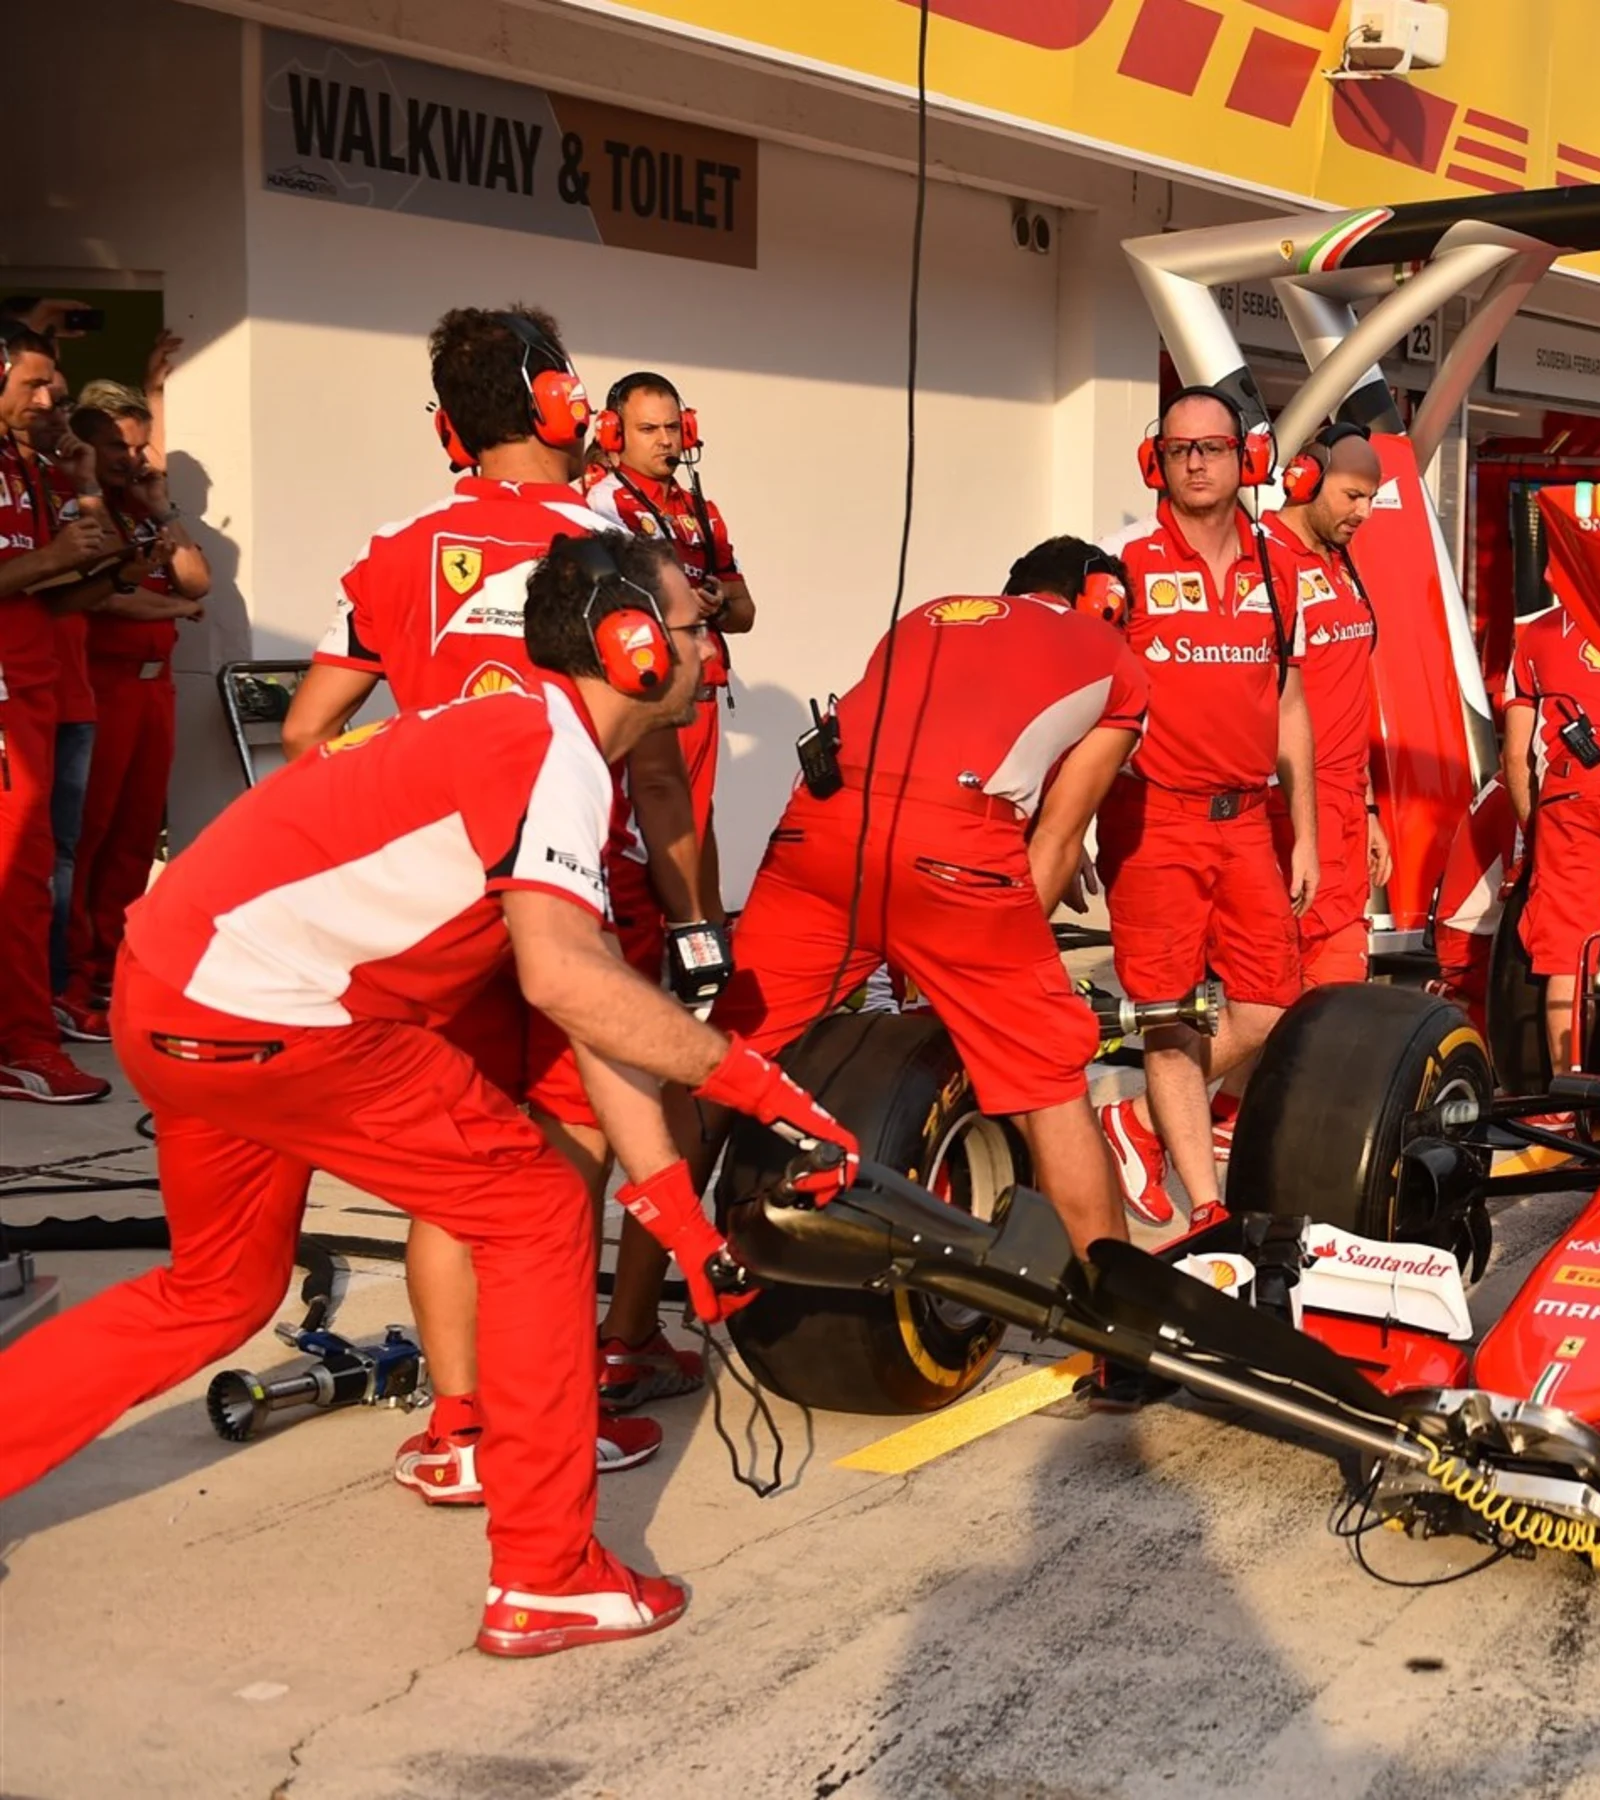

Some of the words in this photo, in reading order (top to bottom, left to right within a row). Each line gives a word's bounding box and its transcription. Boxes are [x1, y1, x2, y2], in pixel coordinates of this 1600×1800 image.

[288, 73, 542, 196] WALKWAY
[558, 131, 591, 207] &
[605, 139, 741, 231] TOILET
[1413, 323, 1431, 355] 23
[1338, 1244, 1452, 1278] Santander
